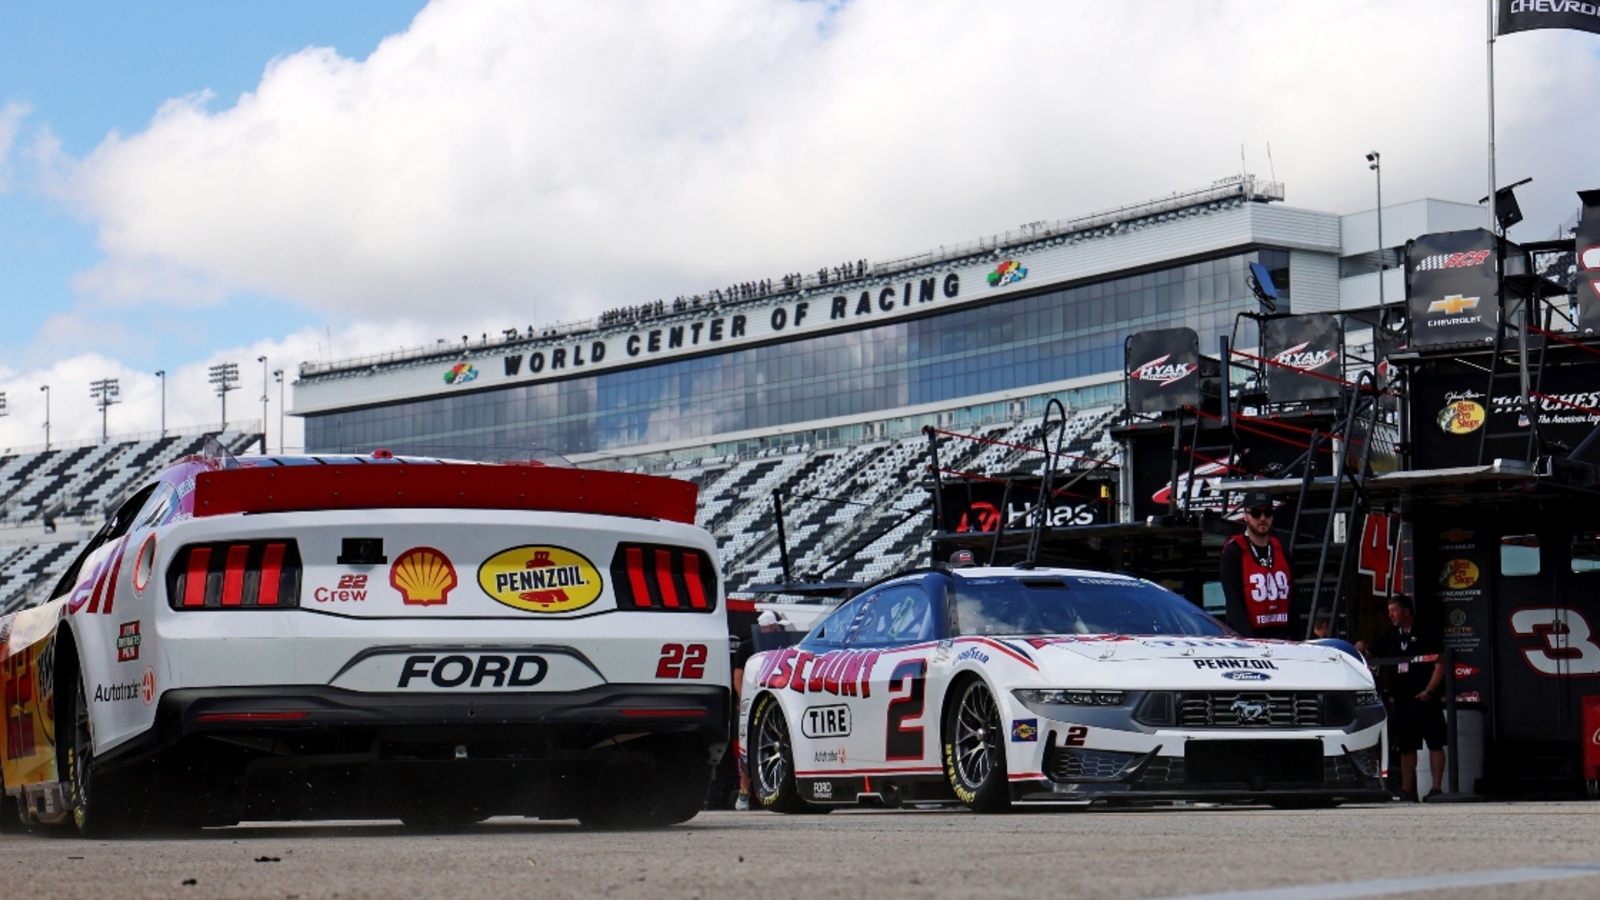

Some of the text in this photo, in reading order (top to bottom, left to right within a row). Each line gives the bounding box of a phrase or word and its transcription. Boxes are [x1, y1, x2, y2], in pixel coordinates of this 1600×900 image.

[1511, 0, 1600, 17] CHEVRO
[504, 273, 960, 377] WORLD CENTER OF RACING
[1427, 315, 1483, 327] CHEVROLET
[1279, 349, 1331, 364] HYAK
[1140, 363, 1189, 377] HYAK
[337, 574, 368, 589] 22
[495, 565, 585, 593] PENNZOIL
[314, 587, 368, 602] Crew
[1507, 605, 1600, 678] 3
[397, 655, 549, 687] FORD
[656, 643, 708, 679] 22
[1193, 659, 1279, 670] PENNZOIL
[885, 658, 928, 762] 2
[809, 708, 847, 734] TIRE
[1064, 726, 1088, 746] 2
